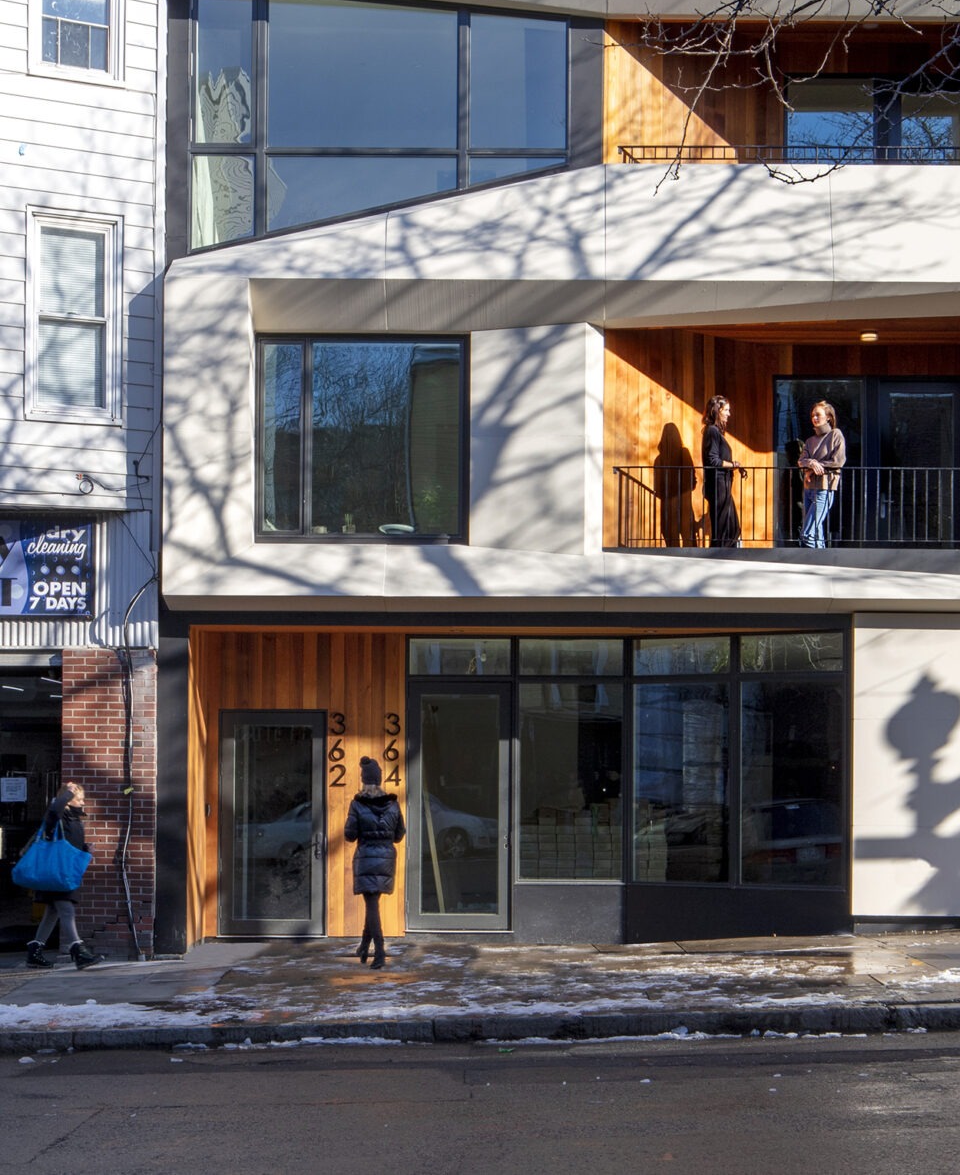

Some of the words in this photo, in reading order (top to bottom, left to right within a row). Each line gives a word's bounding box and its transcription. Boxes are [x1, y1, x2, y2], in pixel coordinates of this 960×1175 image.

[47, 526, 86, 541] dry
[27, 534, 87, 560] cleaning
[33, 581, 87, 596] OPEN
[30, 597, 41, 610] 7
[45, 597, 87, 610] DAYS
[328, 713, 347, 788] 362
[383, 713, 402, 787] 364
